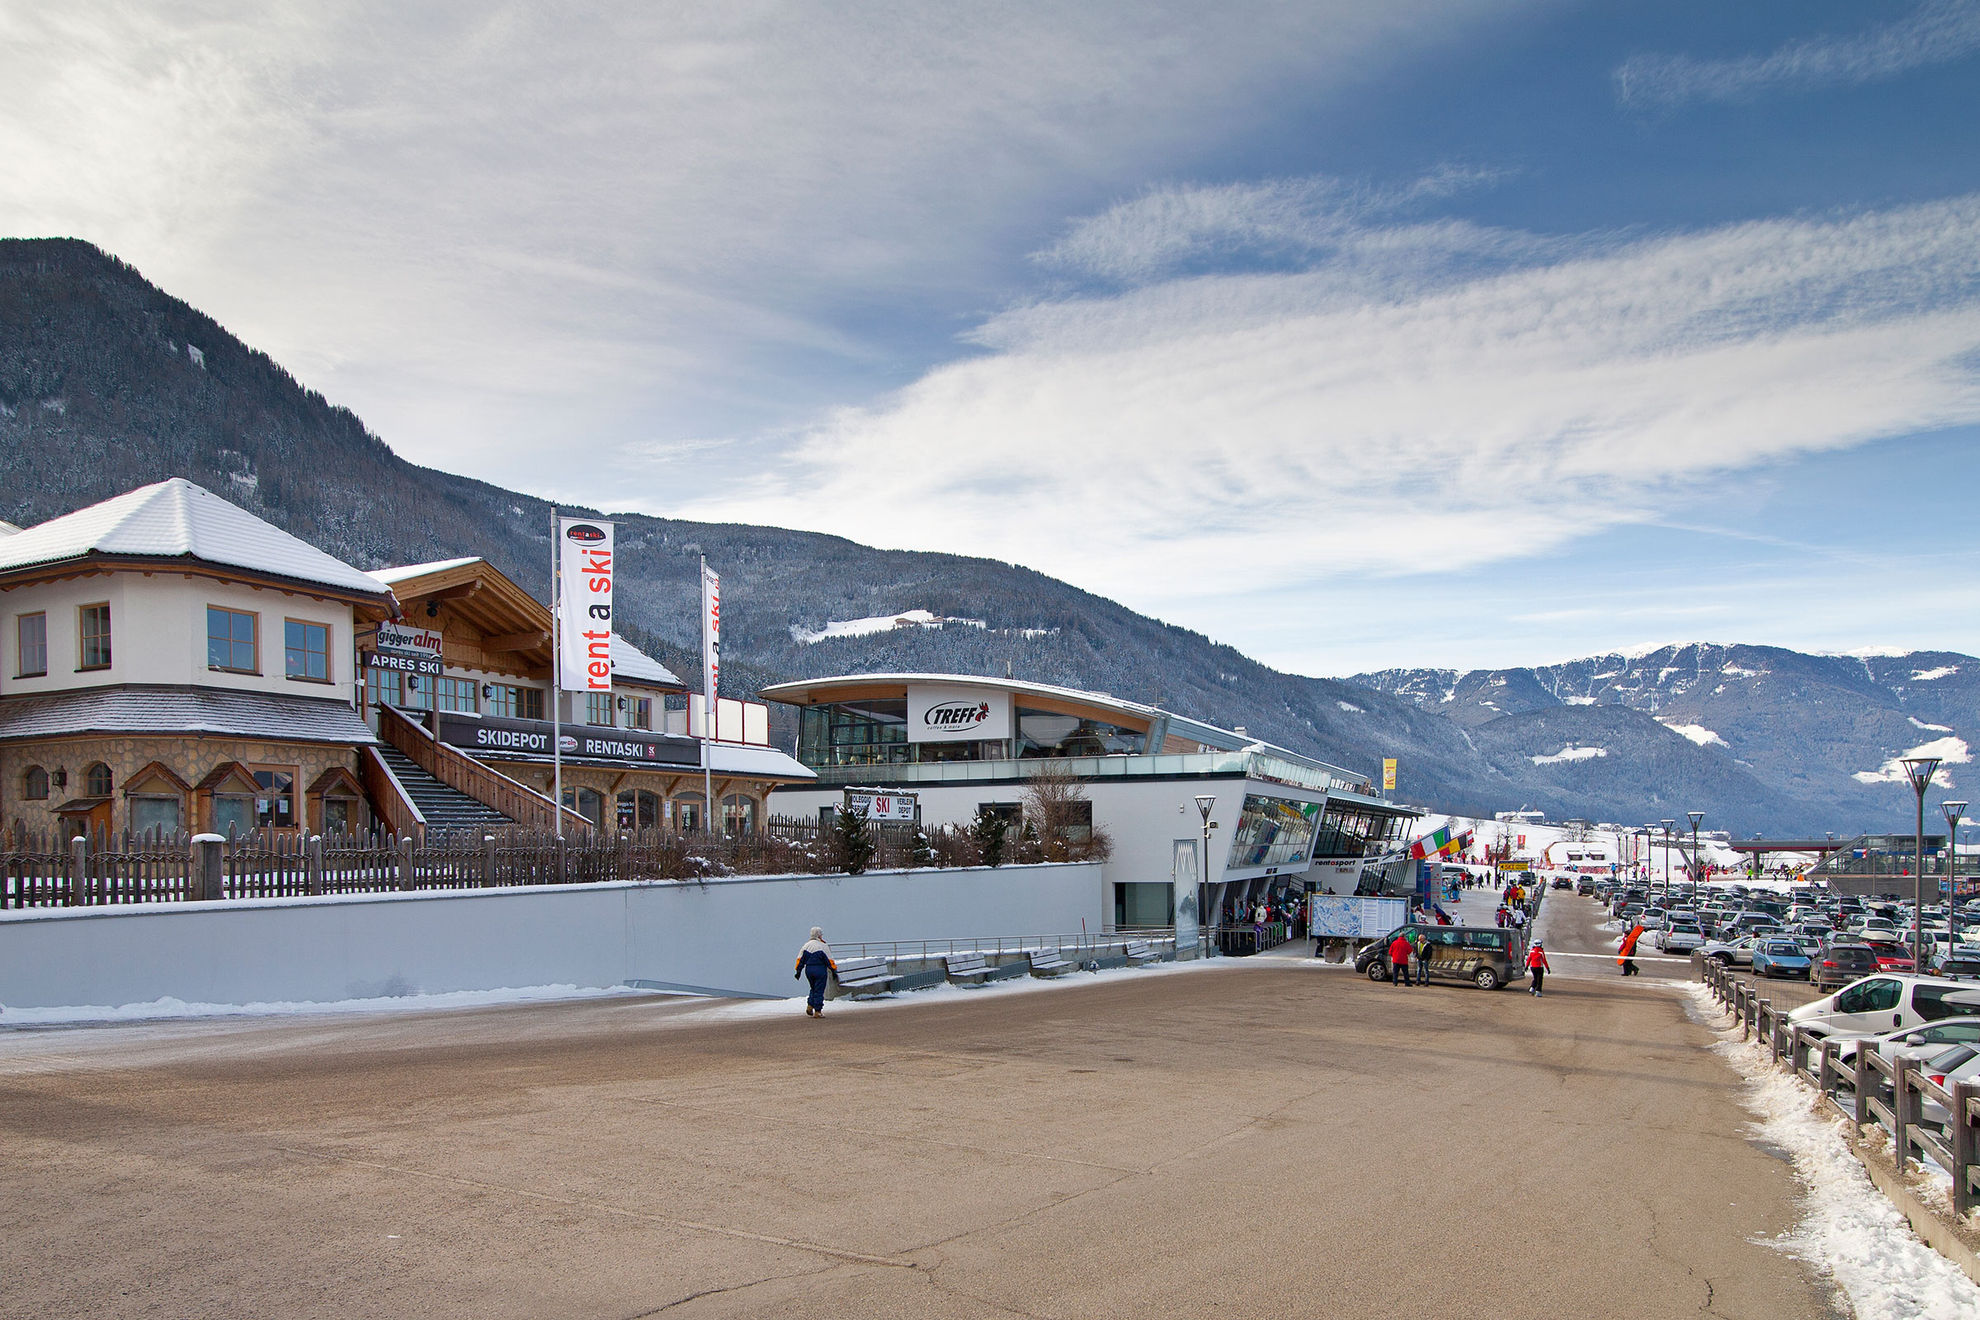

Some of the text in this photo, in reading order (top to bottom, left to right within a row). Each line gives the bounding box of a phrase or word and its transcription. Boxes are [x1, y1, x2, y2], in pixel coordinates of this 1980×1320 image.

[581, 549, 611, 689] rent a ski
[371, 654, 440, 674] APRES SKI
[934, 707, 977, 725] TREFF
[477, 728, 547, 749] SKIDEPOT
[586, 739, 643, 757] RENTASKI
[876, 796, 890, 813] SKI
